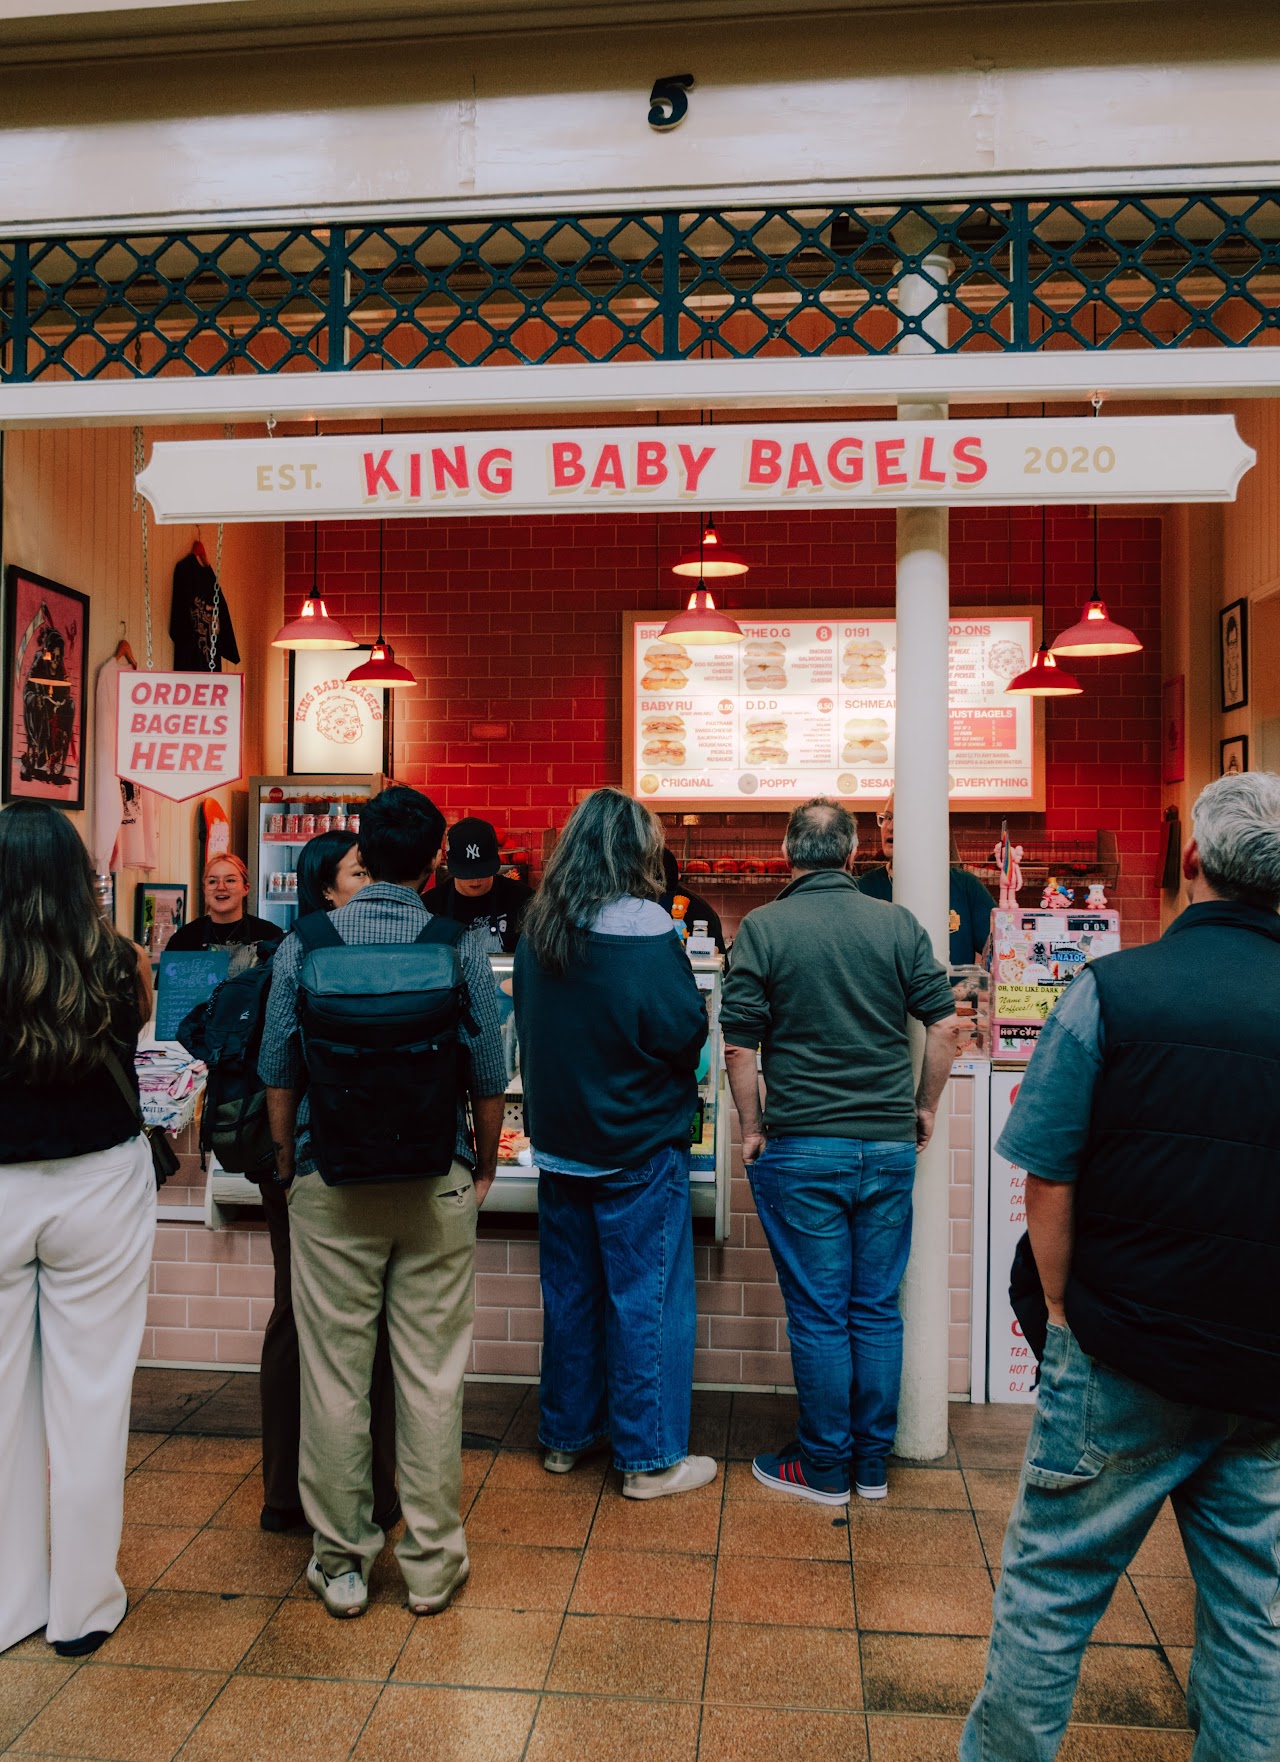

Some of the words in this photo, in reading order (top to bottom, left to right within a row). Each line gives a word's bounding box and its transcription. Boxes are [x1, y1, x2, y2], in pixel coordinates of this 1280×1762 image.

[648, 73, 694, 129] 5
[256, 463, 323, 492] EST.
[359, 445, 513, 504] KING
[547, 440, 716, 499] BABY
[740, 436, 988, 496] BAGELS
[1023, 445, 1116, 474] 2020
[743, 628, 768, 638] THE
[769, 628, 791, 638] O.G
[820, 628, 827, 639] 8
[844, 627, 870, 638] 0191
[131, 682, 229, 706] ORDER
[295, 692, 315, 722] KING
[313, 679, 346, 696] BABY
[349, 685, 383, 721] BAGELS
[745, 700, 778, 710] D.D.D
[641, 701, 674, 711] BABY
[675, 701, 693, 711] RU
[817, 702, 833, 711] 8.50
[949, 710, 973, 718] JUST
[974, 710, 1013, 718] BAGELS
[130, 713, 228, 736] BAGELS
[129, 741, 227, 771] HERE
[661, 778, 714, 788] ORIGINAL
[759, 778, 798, 788] POPPY
[955, 778, 1029, 787] EVERYTHING
[465, 843, 481, 860] NY
[999, 996, 1021, 1004] Name
[1010, 1347, 1028, 1357] TEA
[1009, 1365, 1029, 1375] HOT
[1009, 1382, 1024, 1392] OJ
